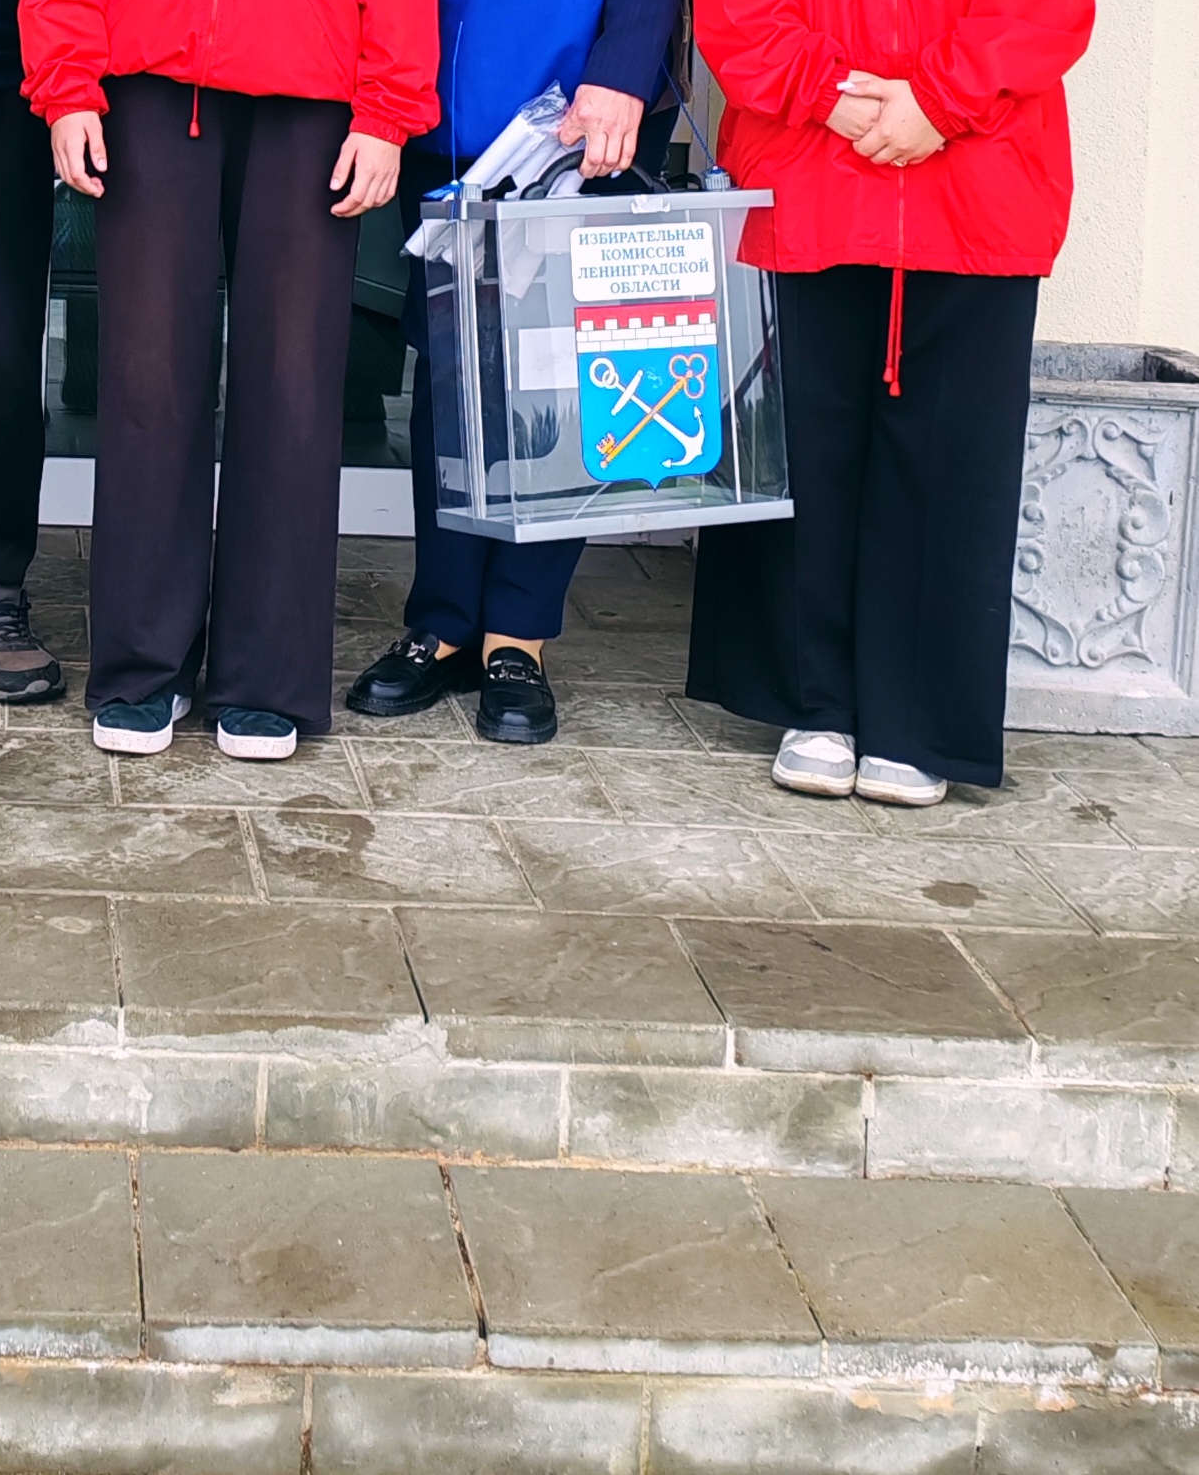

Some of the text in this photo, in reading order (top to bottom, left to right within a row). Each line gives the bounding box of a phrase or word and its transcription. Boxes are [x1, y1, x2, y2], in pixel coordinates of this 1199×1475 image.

[579, 228, 705, 246] ИЗБИРАТЕЛЬНАЯ
[601, 245, 685, 262] КОМИССИЯ
[578, 258, 709, 279] ЛЕНИНГРАДСКОЙ
[610, 278, 681, 294] ОБЛАСТИ
